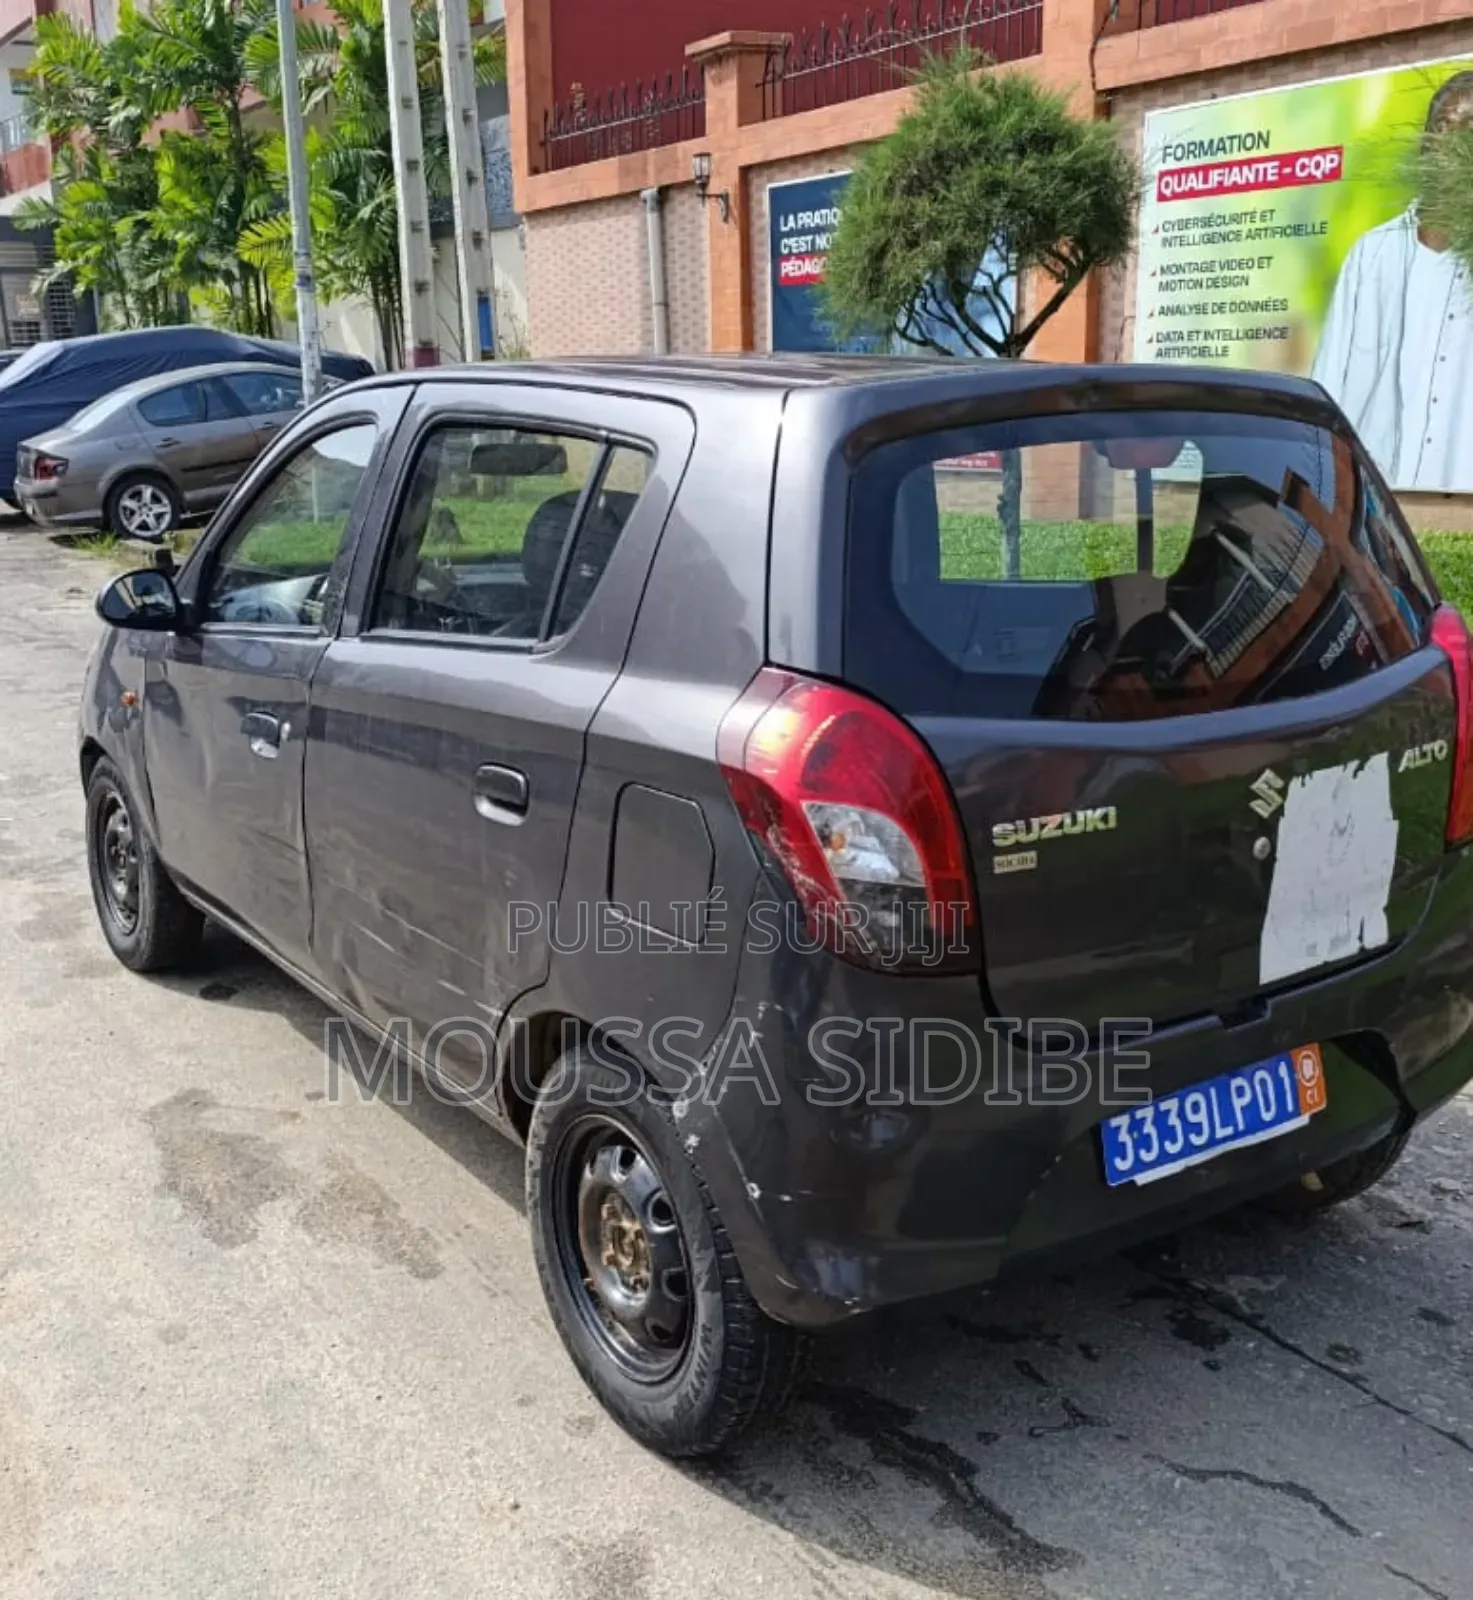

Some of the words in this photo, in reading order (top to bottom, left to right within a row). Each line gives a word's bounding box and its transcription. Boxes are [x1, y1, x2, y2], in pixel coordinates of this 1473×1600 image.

[1161, 130, 1271, 164] FORMATION
[1159, 161, 1280, 197] QUALIFIANTE
[1295, 153, 1341, 179] CQP
[780, 214, 796, 232] LA
[797, 207, 842, 230] PRATIQ
[1162, 208, 1259, 233] CYBERSÉCURITÉ
[1259, 209, 1276, 223] ET
[781, 235, 813, 254] C'EST
[815, 233, 834, 251] NO
[1161, 230, 1243, 248] INTELLIGENCE
[1245, 220, 1329, 241] ARTIFICIELLE
[781, 256, 828, 278] PÉDAGO
[1160, 259, 1217, 277] MONTAGE
[1257, 256, 1274, 269] ET
[1158, 278, 1203, 292] MOTION
[1205, 275, 1250, 289] DESIGN
[1158, 301, 1209, 317] ANALYSE
[1211, 301, 1228, 314] DE
[1229, 296, 1289, 314] DONNÉES
[1156, 330, 1184, 343] DATA
[1186, 329, 1202, 341] ET
[1203, 327, 1289, 342] INTELLIGENCE
[1155, 345, 1230, 359] ARTIFICIELLE
[1398, 739, 1448, 773] ALTO
[992, 806, 1118, 847] SUZUKI
[1109, 1060, 1295, 1171] 3339LP01
